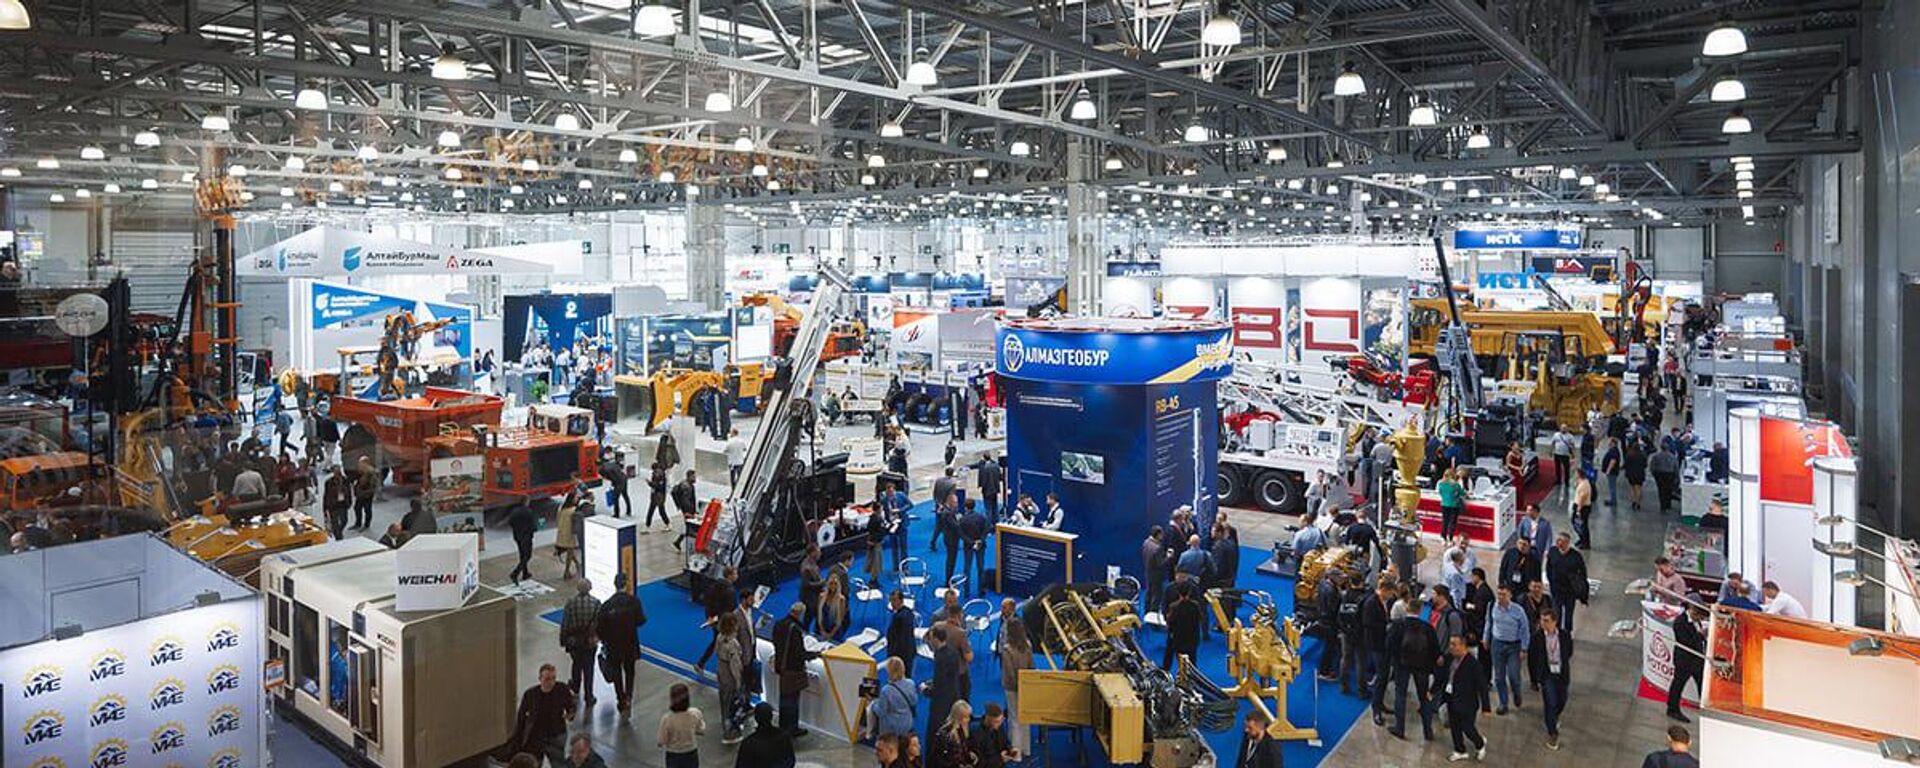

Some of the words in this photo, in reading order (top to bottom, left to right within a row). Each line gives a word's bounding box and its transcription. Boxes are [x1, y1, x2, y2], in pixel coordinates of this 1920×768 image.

[1486, 233, 1522, 245] ИСТК
[366, 251, 440, 262] АлтайБурМаш
[461, 258, 493, 267] ZEGA
[1024, 348, 1109, 367] АЛМАЗГЕОБУР
[398, 574, 457, 585] WEICHAI
